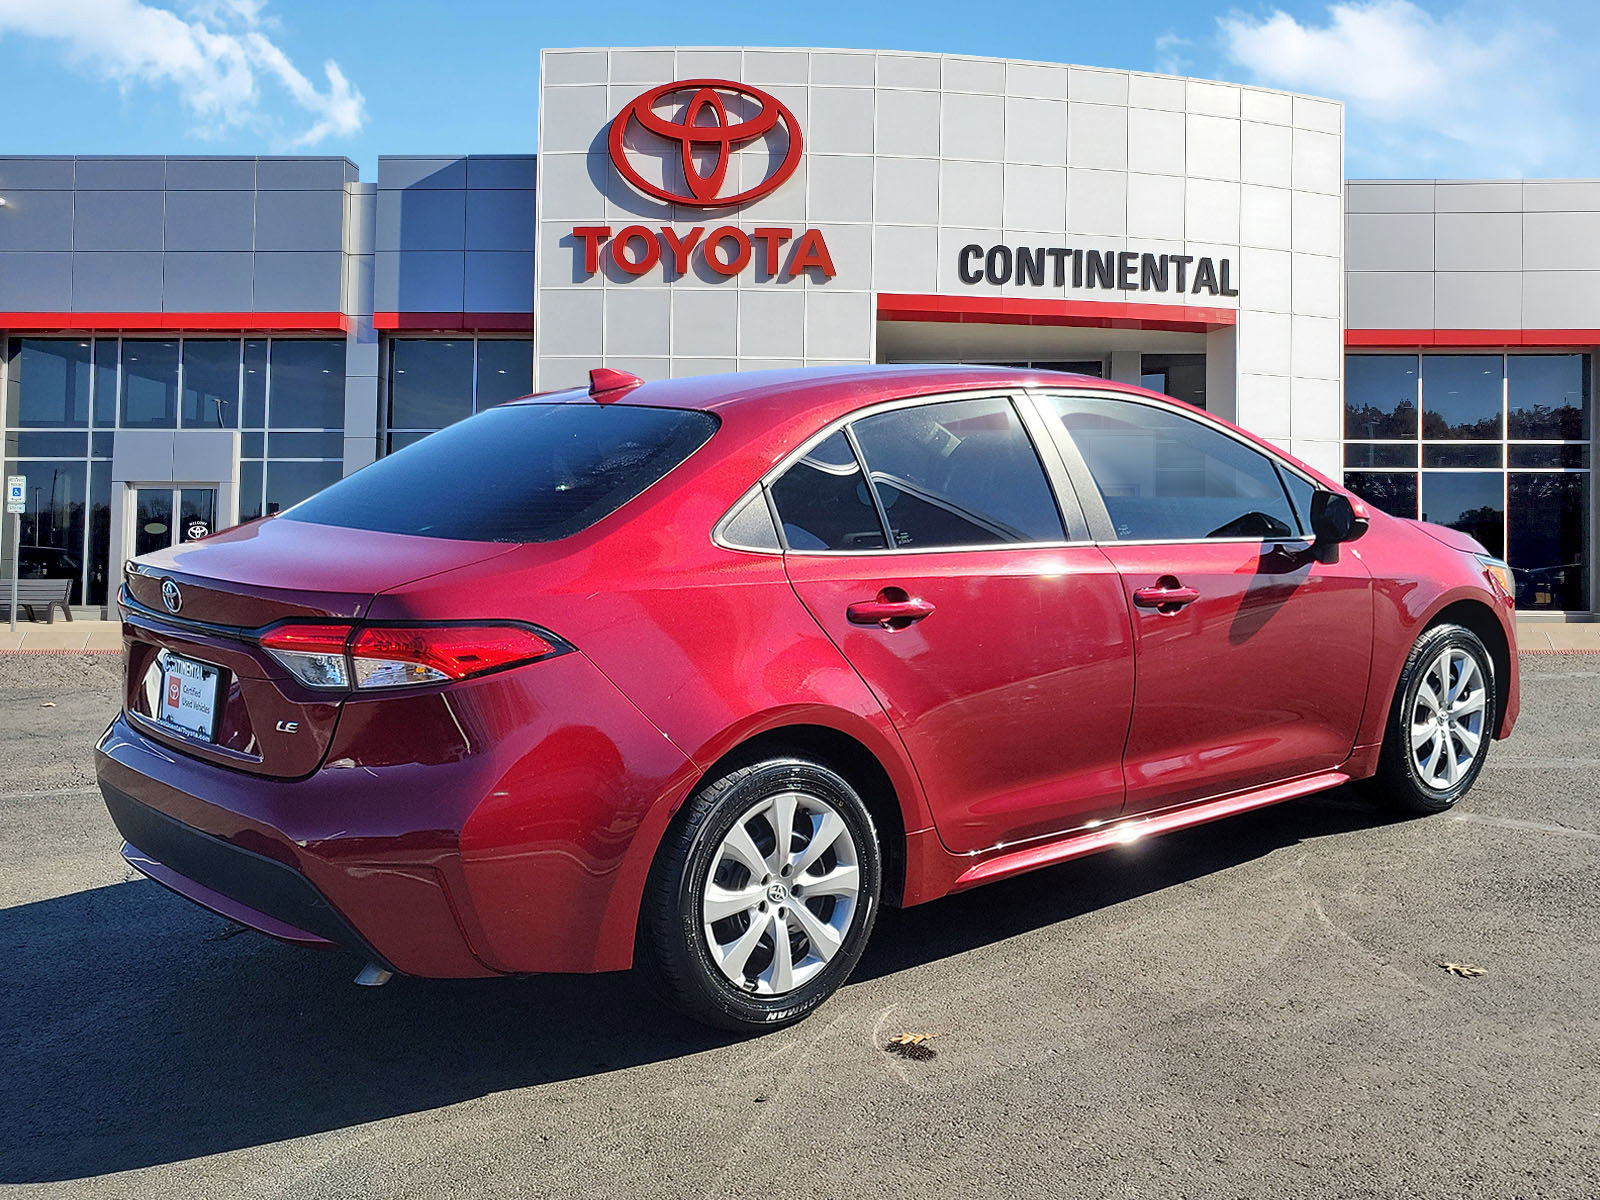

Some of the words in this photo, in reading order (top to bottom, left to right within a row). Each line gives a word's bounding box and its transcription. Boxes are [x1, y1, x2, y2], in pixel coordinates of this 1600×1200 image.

[572, 225, 837, 277] TOYOTA
[958, 244, 1239, 297] CONTINENTAL
[183, 684, 201, 698] Certified
[182, 697, 193, 709] Used
[193, 700, 210, 714] Vehicles
[275, 719, 300, 734] LE
